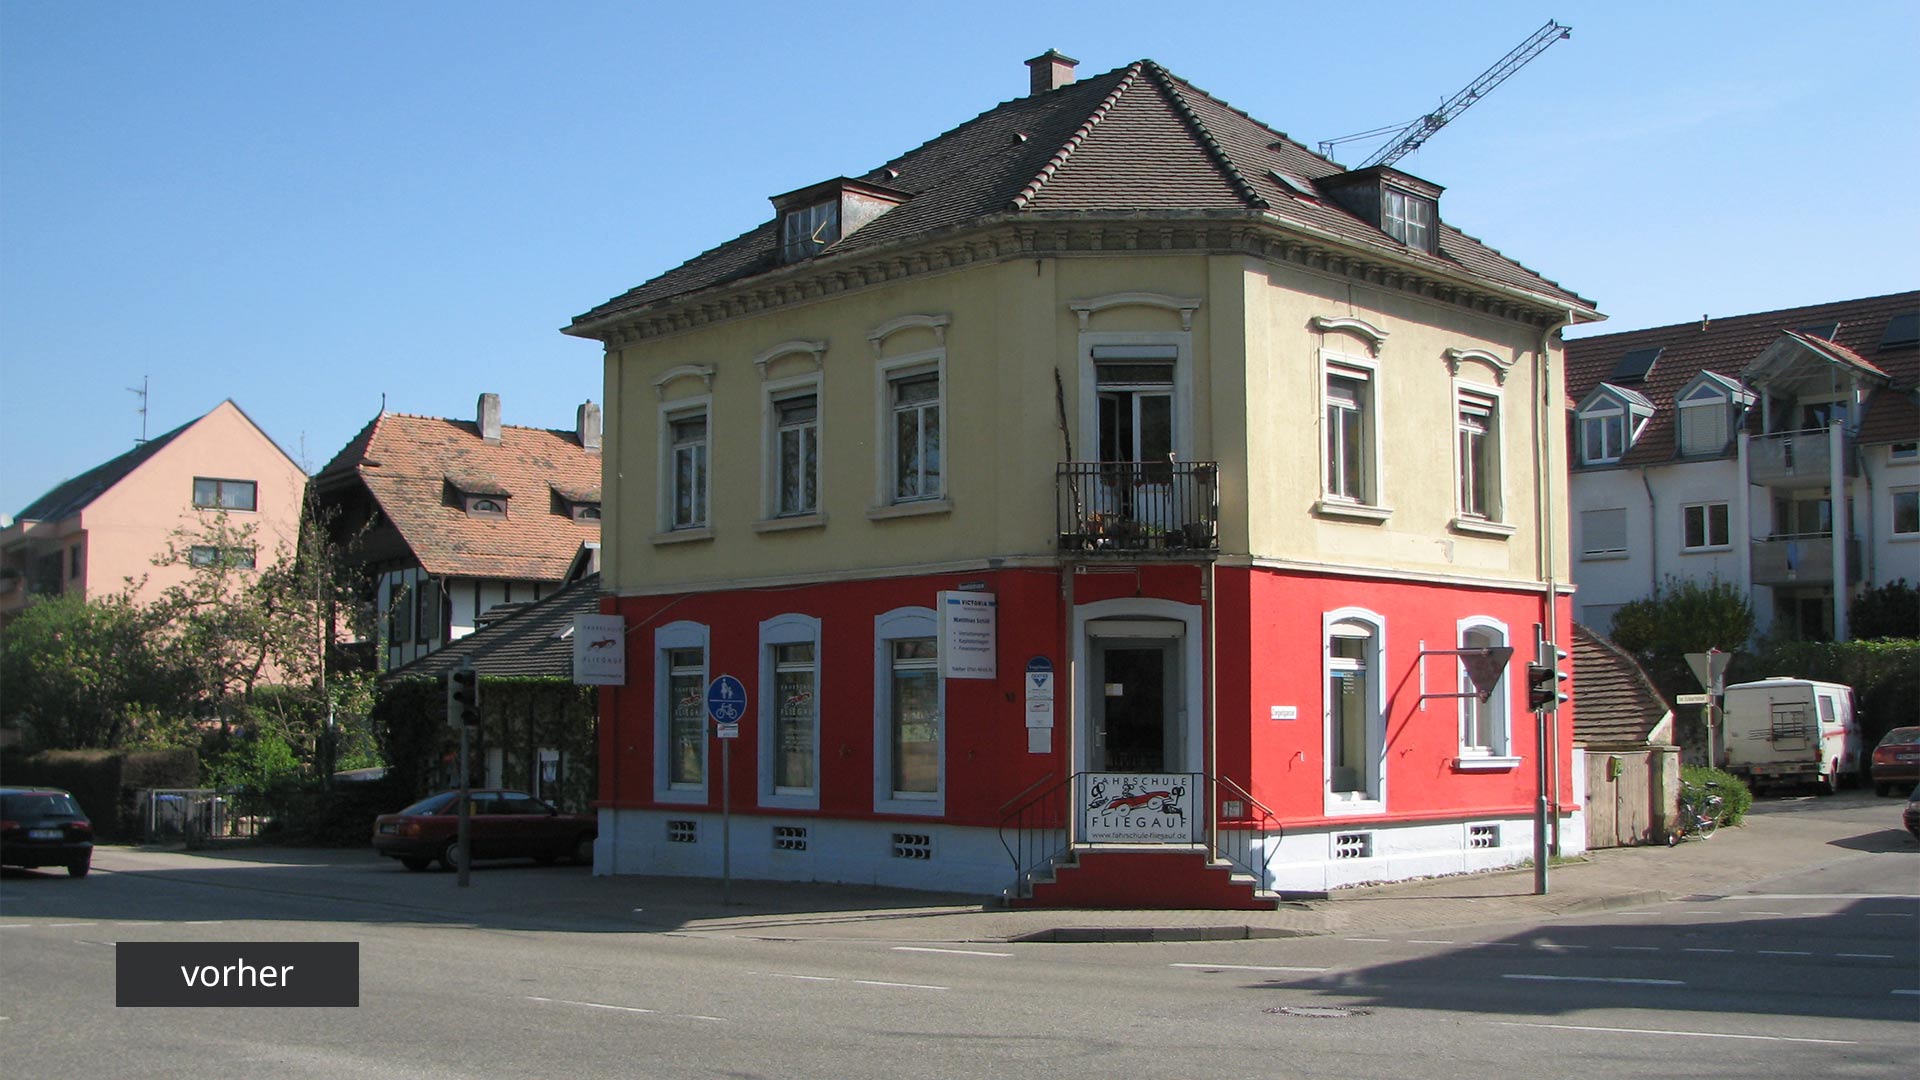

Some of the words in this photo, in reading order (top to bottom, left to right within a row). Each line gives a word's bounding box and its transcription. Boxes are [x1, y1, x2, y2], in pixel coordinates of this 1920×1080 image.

[1092, 777, 1187, 786] FAHRSCHULE
[1092, 817, 1187, 828] FLIEGAUF
[1092, 832, 1187, 840] www.fahrschule-fliegauf.de
